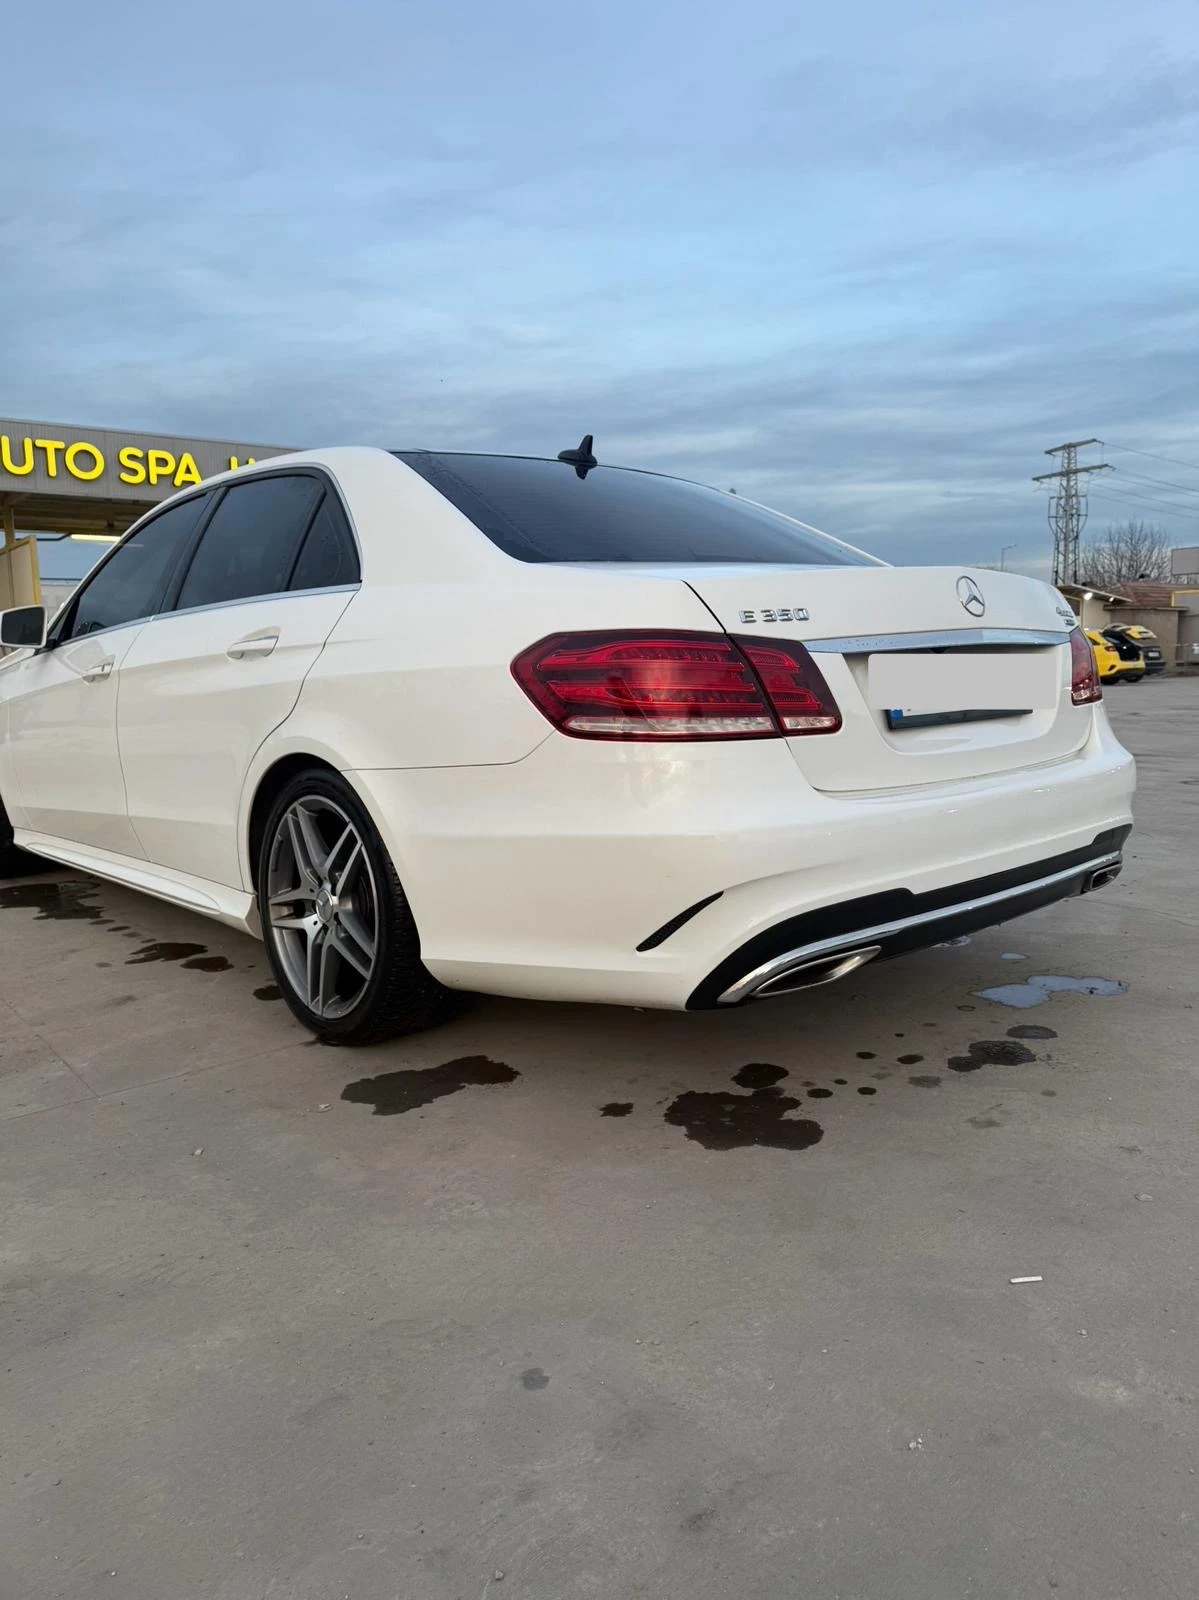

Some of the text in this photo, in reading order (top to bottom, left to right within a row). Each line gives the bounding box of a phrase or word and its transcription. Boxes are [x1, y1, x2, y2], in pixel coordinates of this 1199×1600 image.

[1, 435, 202, 487] UTO SPA
[739, 608, 809, 623] E 350
